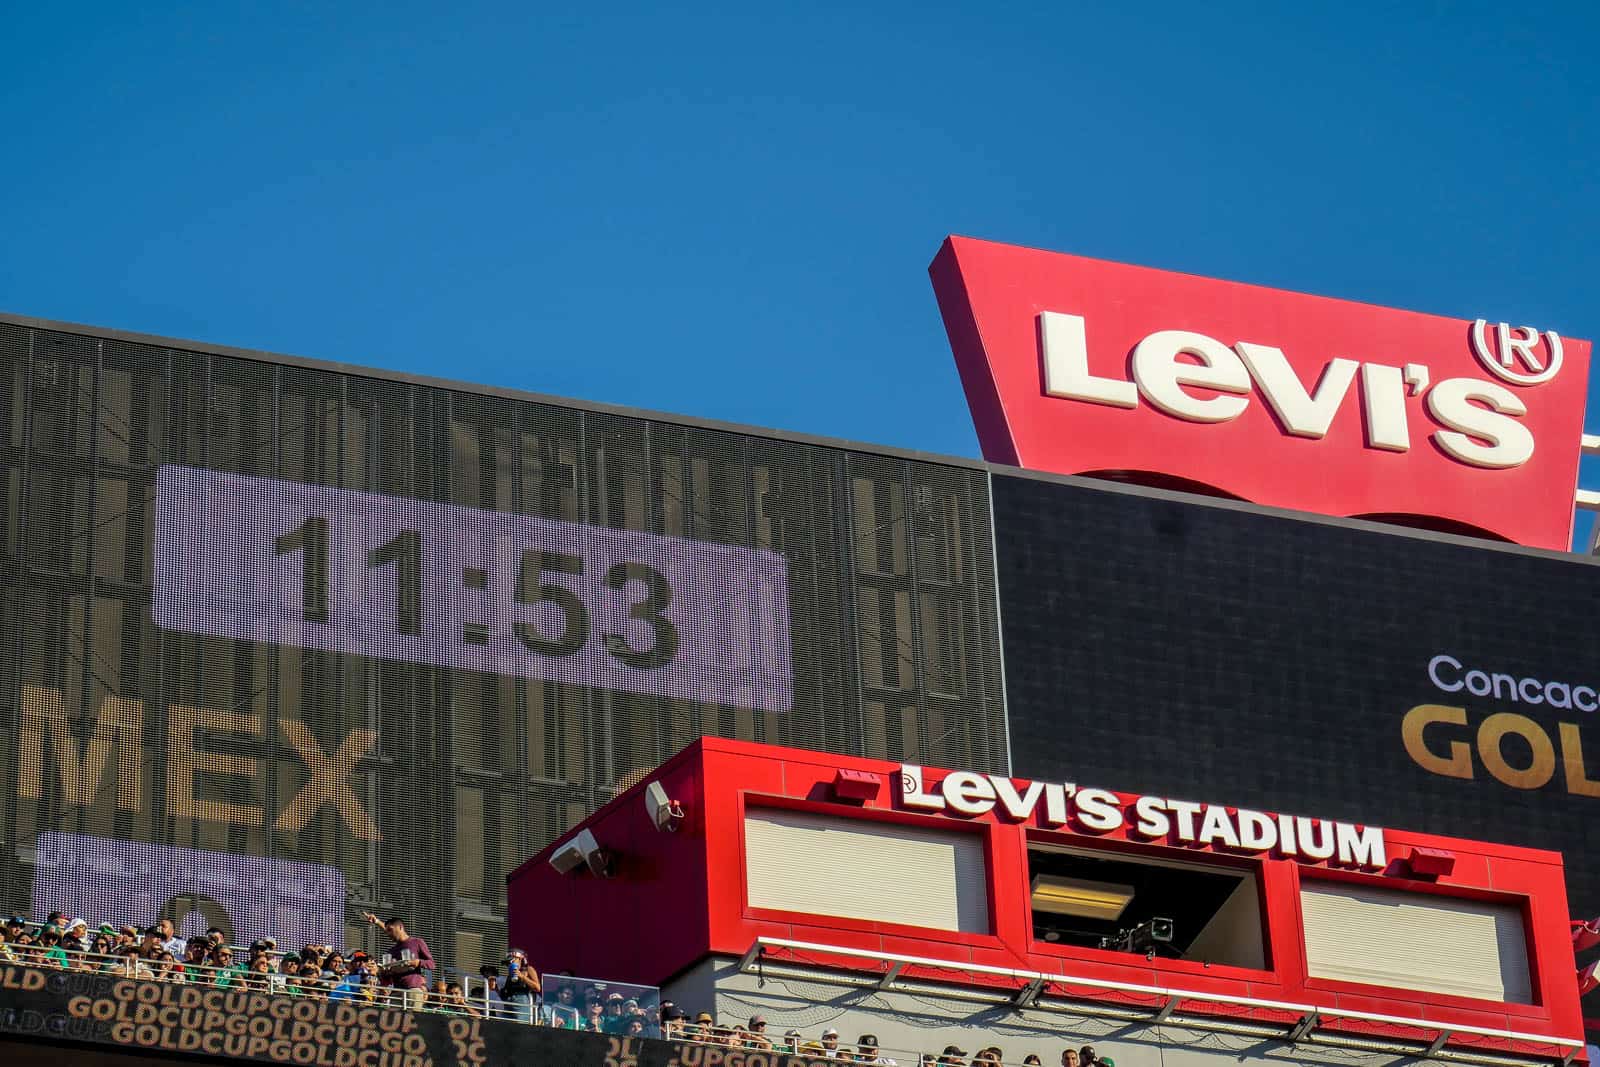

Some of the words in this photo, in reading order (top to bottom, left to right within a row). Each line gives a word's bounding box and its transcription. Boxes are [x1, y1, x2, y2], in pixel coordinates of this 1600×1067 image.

[274, 515, 680, 671] 11:53
[1427, 654, 1600, 712] Concac
[17, 685, 383, 842] MEX
[1401, 703, 1600, 799] GOL
[1136, 796, 1387, 868] STADIUM
[0, 966, 46, 992] LD
